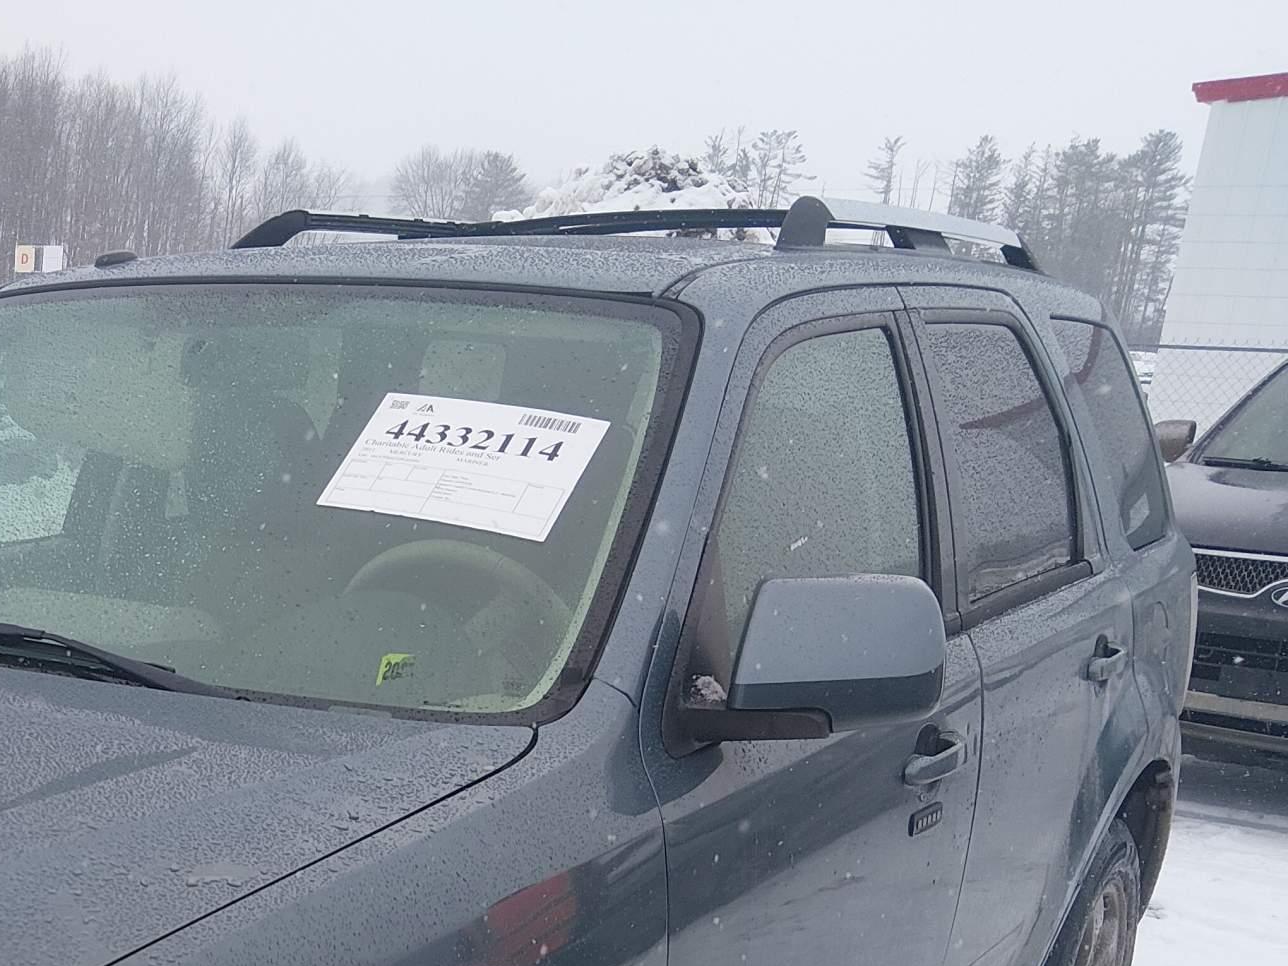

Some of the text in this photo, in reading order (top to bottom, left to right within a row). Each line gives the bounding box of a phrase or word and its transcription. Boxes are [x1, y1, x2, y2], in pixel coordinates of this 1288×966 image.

[21, 253, 29, 265] D
[364, 439, 410, 450] Charitable
[411, 443, 438, 453] Adult
[438, 446, 465, 457] Rides
[465, 450, 485, 459] and
[385, 419, 564, 462] 44332114
